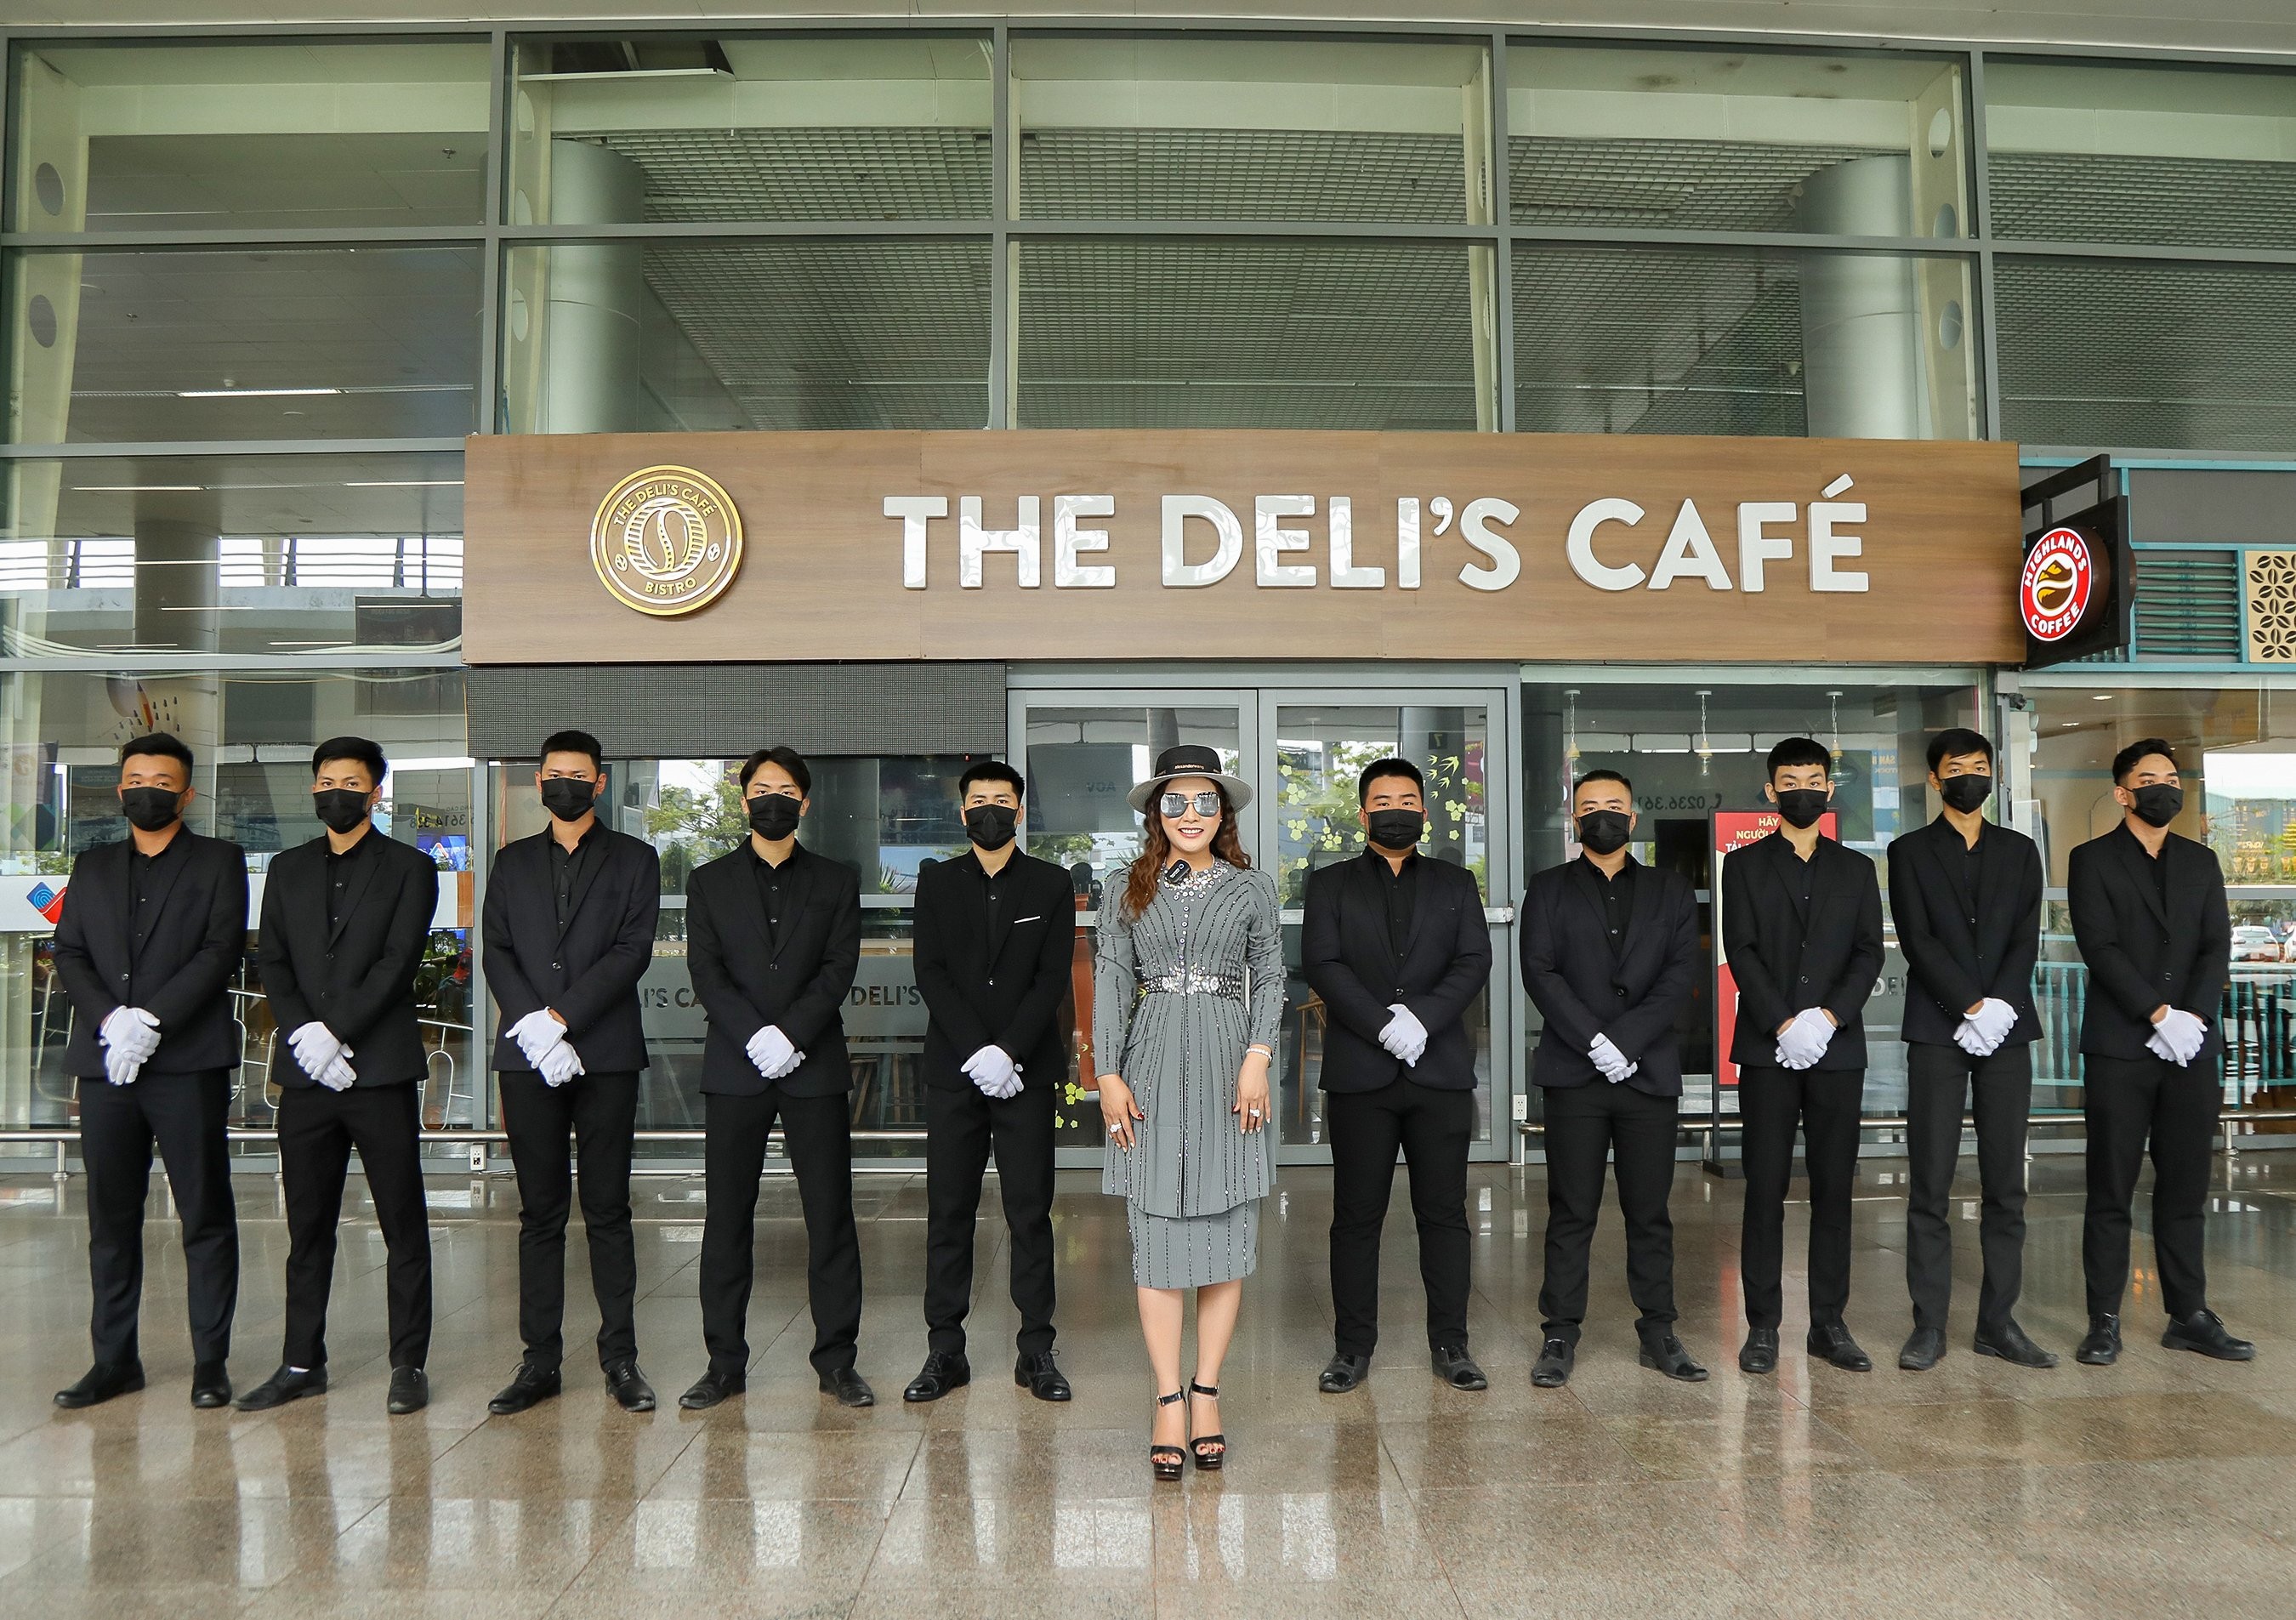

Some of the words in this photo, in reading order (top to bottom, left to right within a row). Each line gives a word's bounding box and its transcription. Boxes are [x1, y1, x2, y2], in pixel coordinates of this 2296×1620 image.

[614, 499, 637, 526] THE
[635, 484, 679, 503] DELI’S
[681, 488, 717, 517] CAFÉ
[883, 495, 1116, 589] THE
[1161, 495, 1521, 591] DELI’S
[1566, 473, 1869, 593] CAFÉ
[2024, 534, 2087, 588] HIGHLANDS
[645, 577, 696, 595] BISTRO
[2031, 601, 2080, 634] COFFEE
[1759, 816, 1779, 827] HÃY
